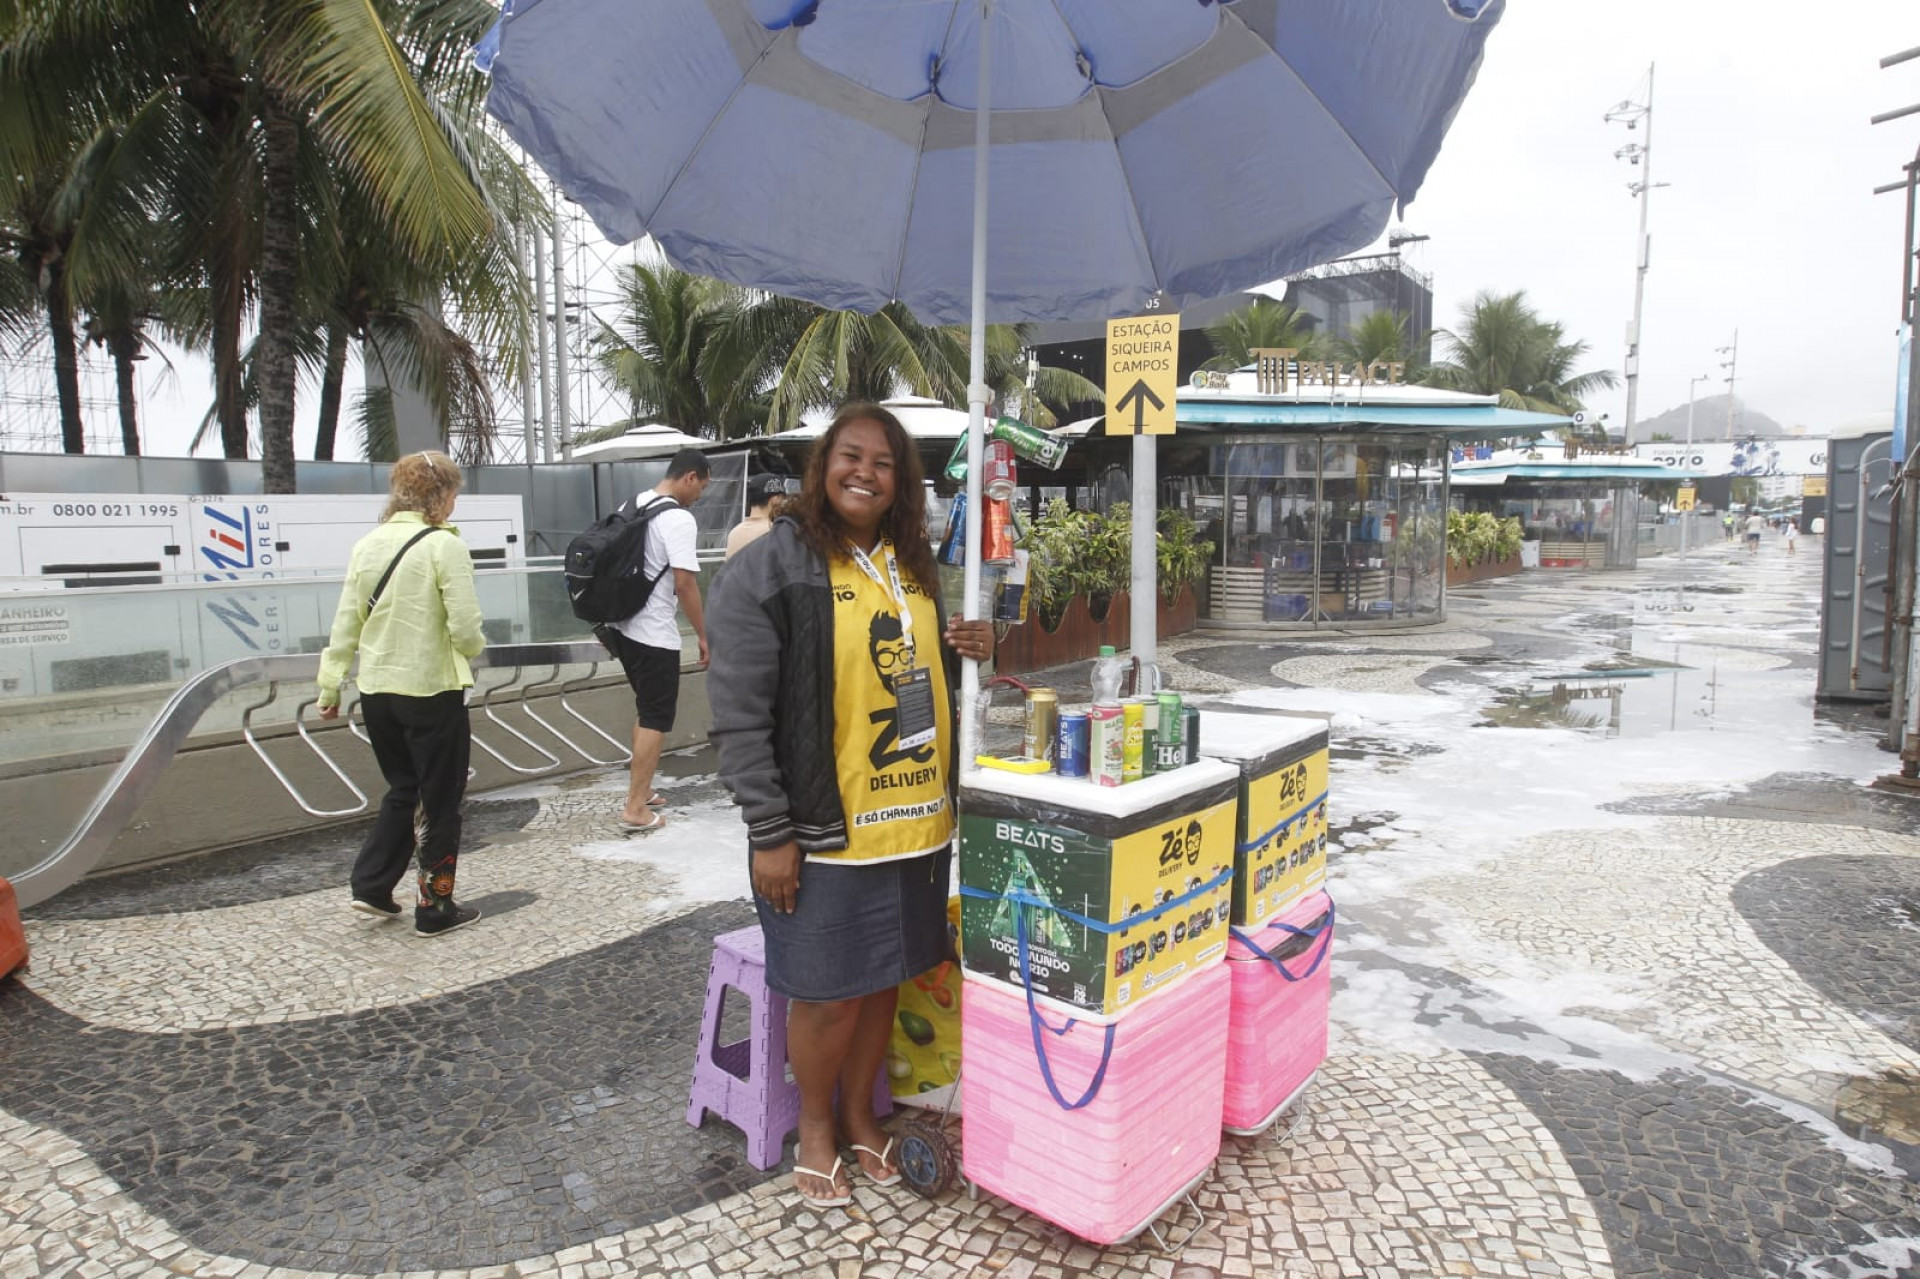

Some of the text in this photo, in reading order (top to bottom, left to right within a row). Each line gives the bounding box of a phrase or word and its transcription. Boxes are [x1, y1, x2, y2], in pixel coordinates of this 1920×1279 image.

[1113, 320, 1172, 338] ESTAÇÃO
[1111, 340, 1172, 356] SIQUEIRA
[1113, 359, 1170, 373] CAMPOS
[1298, 360, 1406, 386] PALACE
[53, 504, 97, 517] 0800
[102, 504, 131, 516] 021
[140, 505, 178, 517] 1995
[870, 766, 937, 792] DELIVERY
[864, 811, 878, 823] SÓ
[880, 804, 924, 822] CHAMAR
[996, 822, 1065, 854] BEATS
[1159, 826, 1183, 867] Zé
